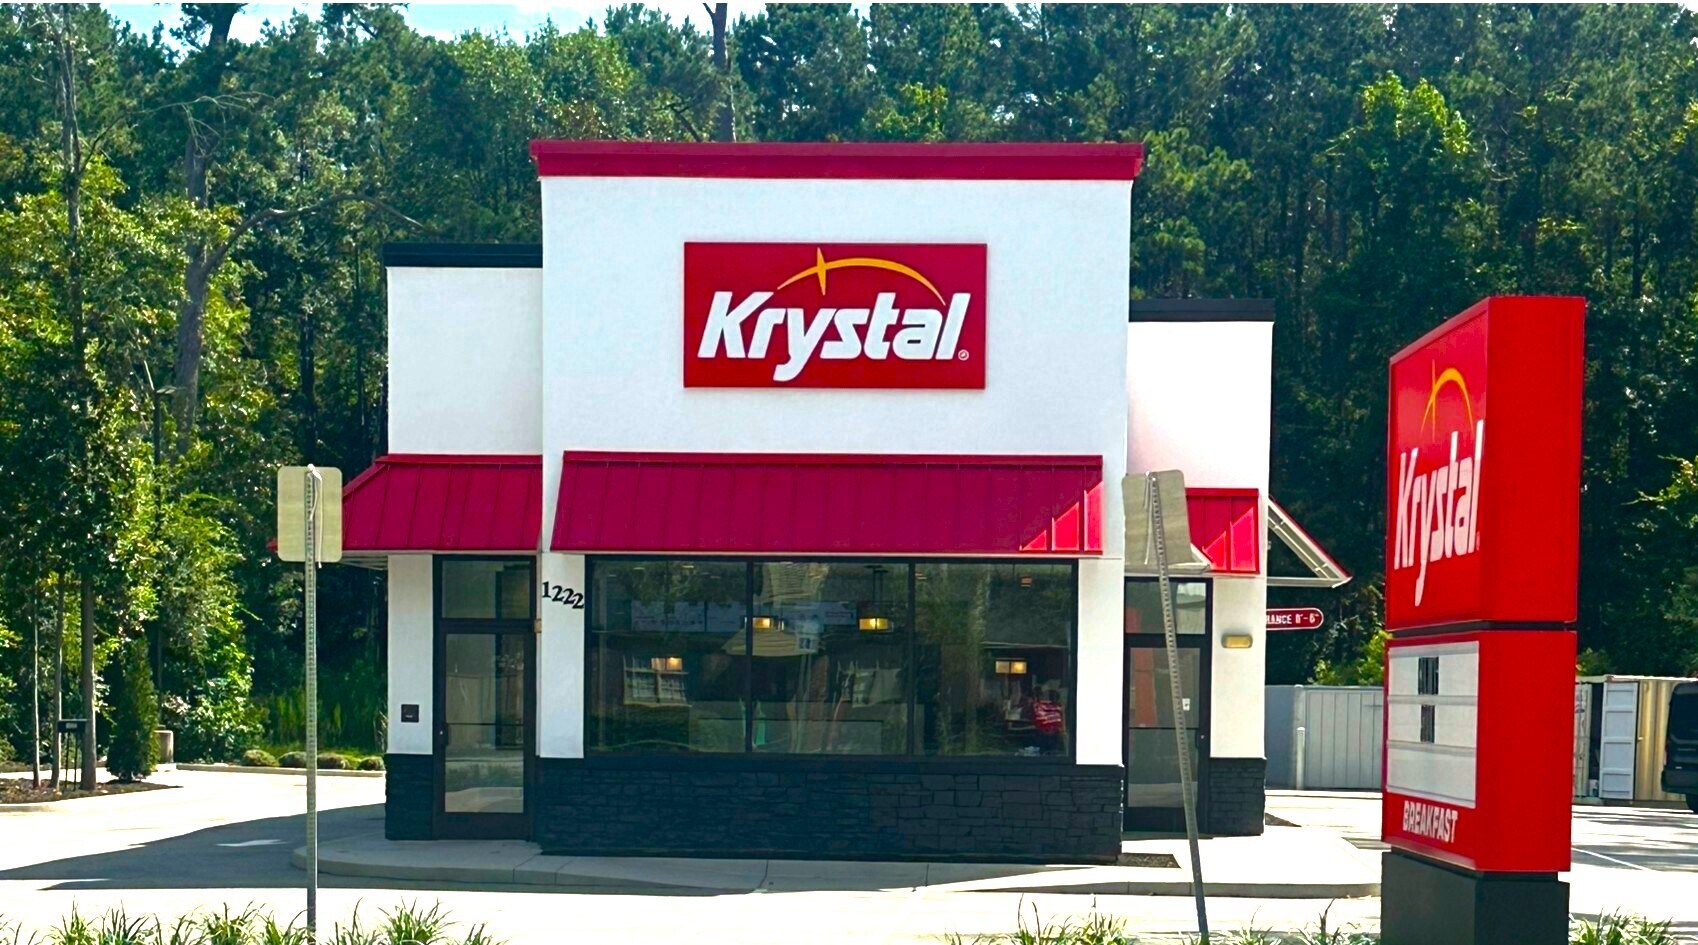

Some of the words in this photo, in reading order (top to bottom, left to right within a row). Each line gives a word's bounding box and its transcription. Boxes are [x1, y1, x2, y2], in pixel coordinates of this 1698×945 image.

[697, 291, 971, 382] Krystal
[1394, 419, 1484, 607] Krystal
[542, 581, 584, 609] 1222
[1403, 800, 1458, 843] BREAKFAST
